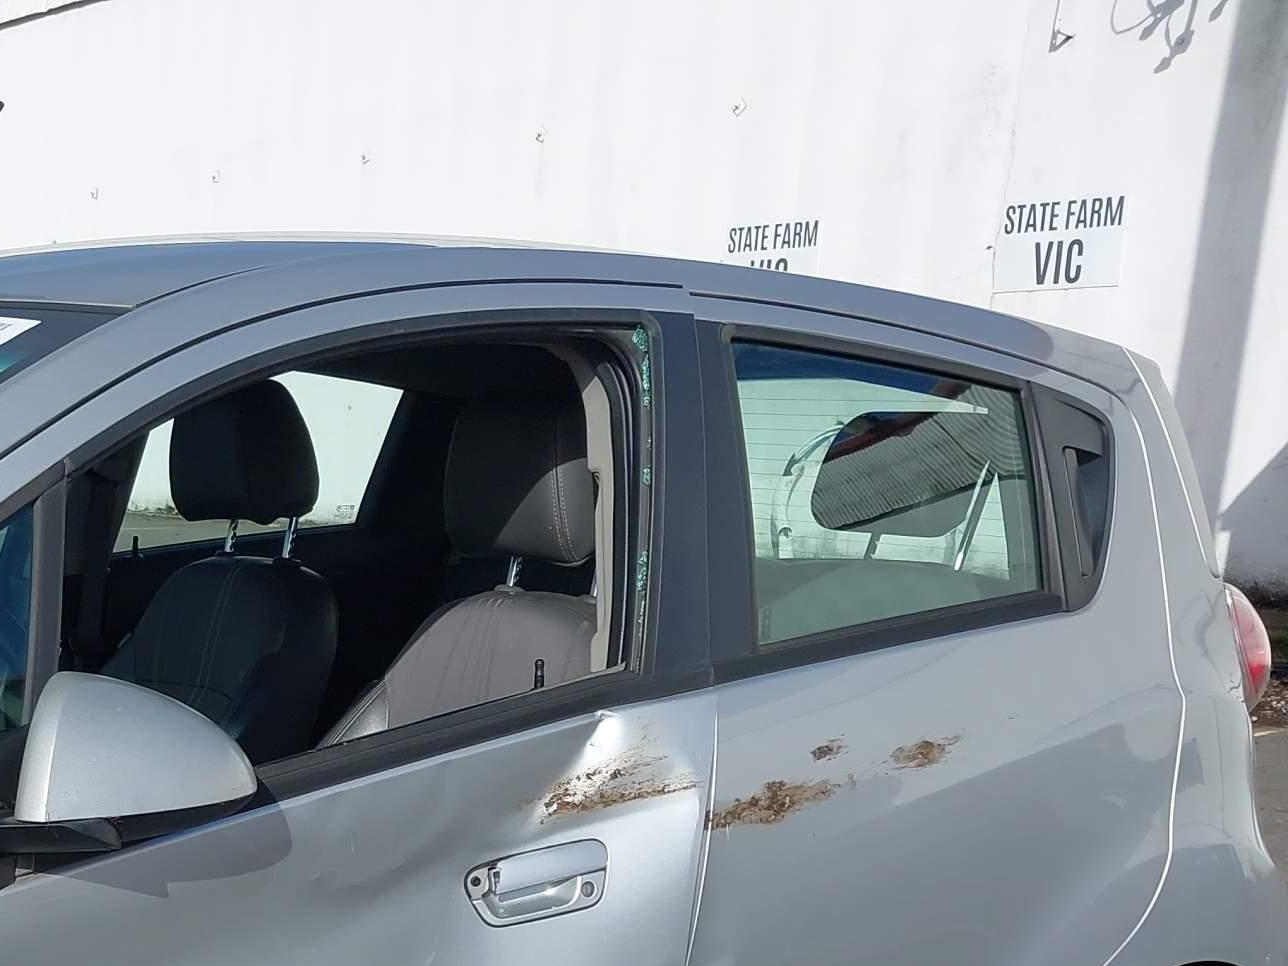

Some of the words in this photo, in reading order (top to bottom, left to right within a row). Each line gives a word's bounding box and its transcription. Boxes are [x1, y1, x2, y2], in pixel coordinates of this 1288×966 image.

[1004, 202, 1060, 235] STATE
[1064, 196, 1125, 231] FARM
[728, 225, 770, 254] STATE
[772, 220, 820, 250] FARM
[1034, 238, 1084, 286] VIC
